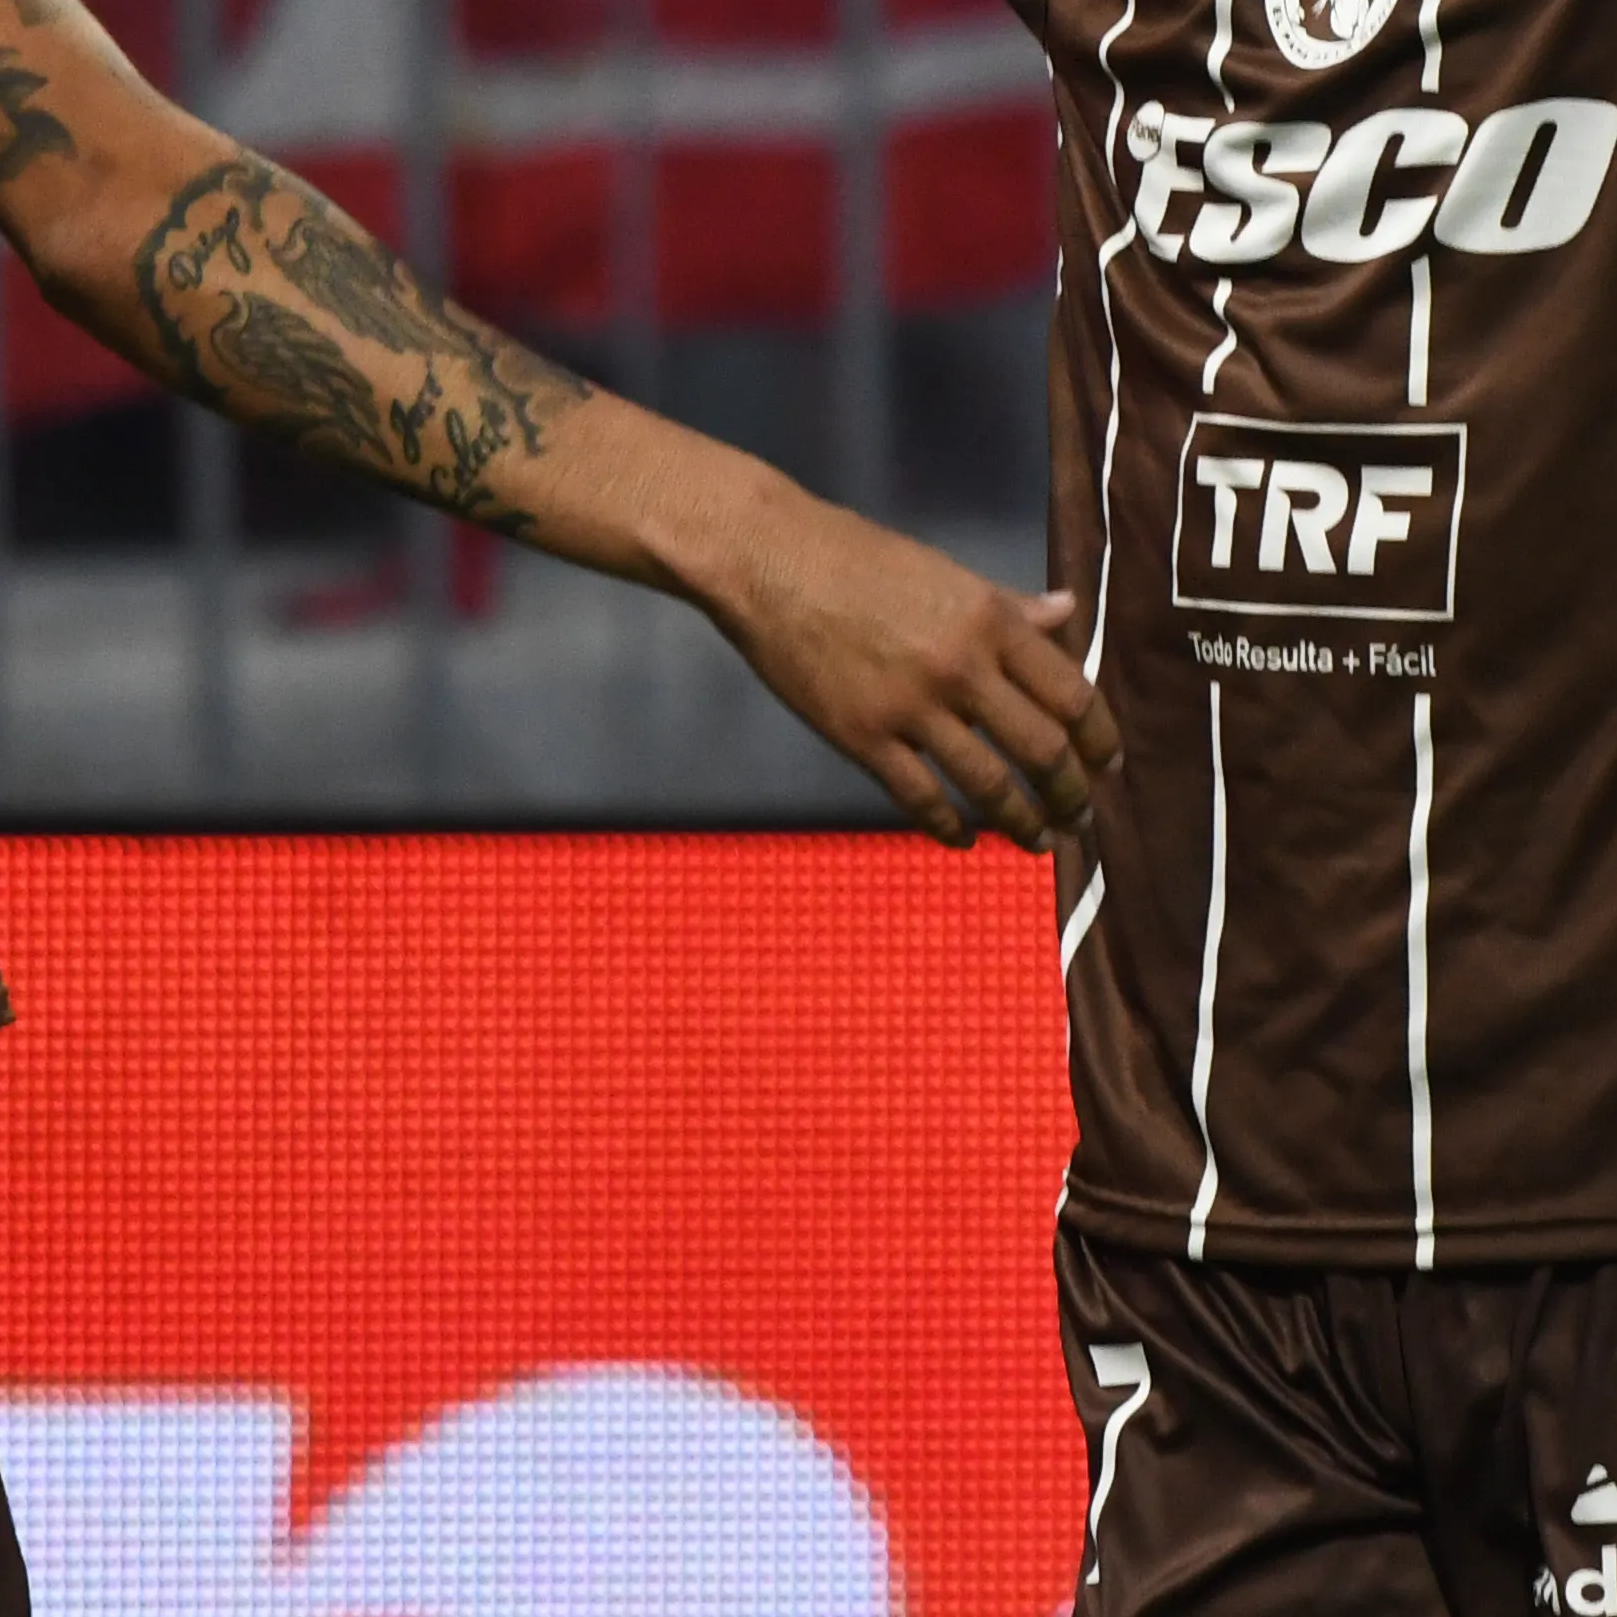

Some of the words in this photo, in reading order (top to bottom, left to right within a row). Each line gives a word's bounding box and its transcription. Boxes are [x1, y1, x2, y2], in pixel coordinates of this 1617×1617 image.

[1195, 455, 1433, 576] TRF
[1188, 631, 1232, 667] Todo
[1236, 635, 1333, 674] Resulta
[1342, 648, 1361, 675] +
[1369, 642, 1437, 678] Fácil
